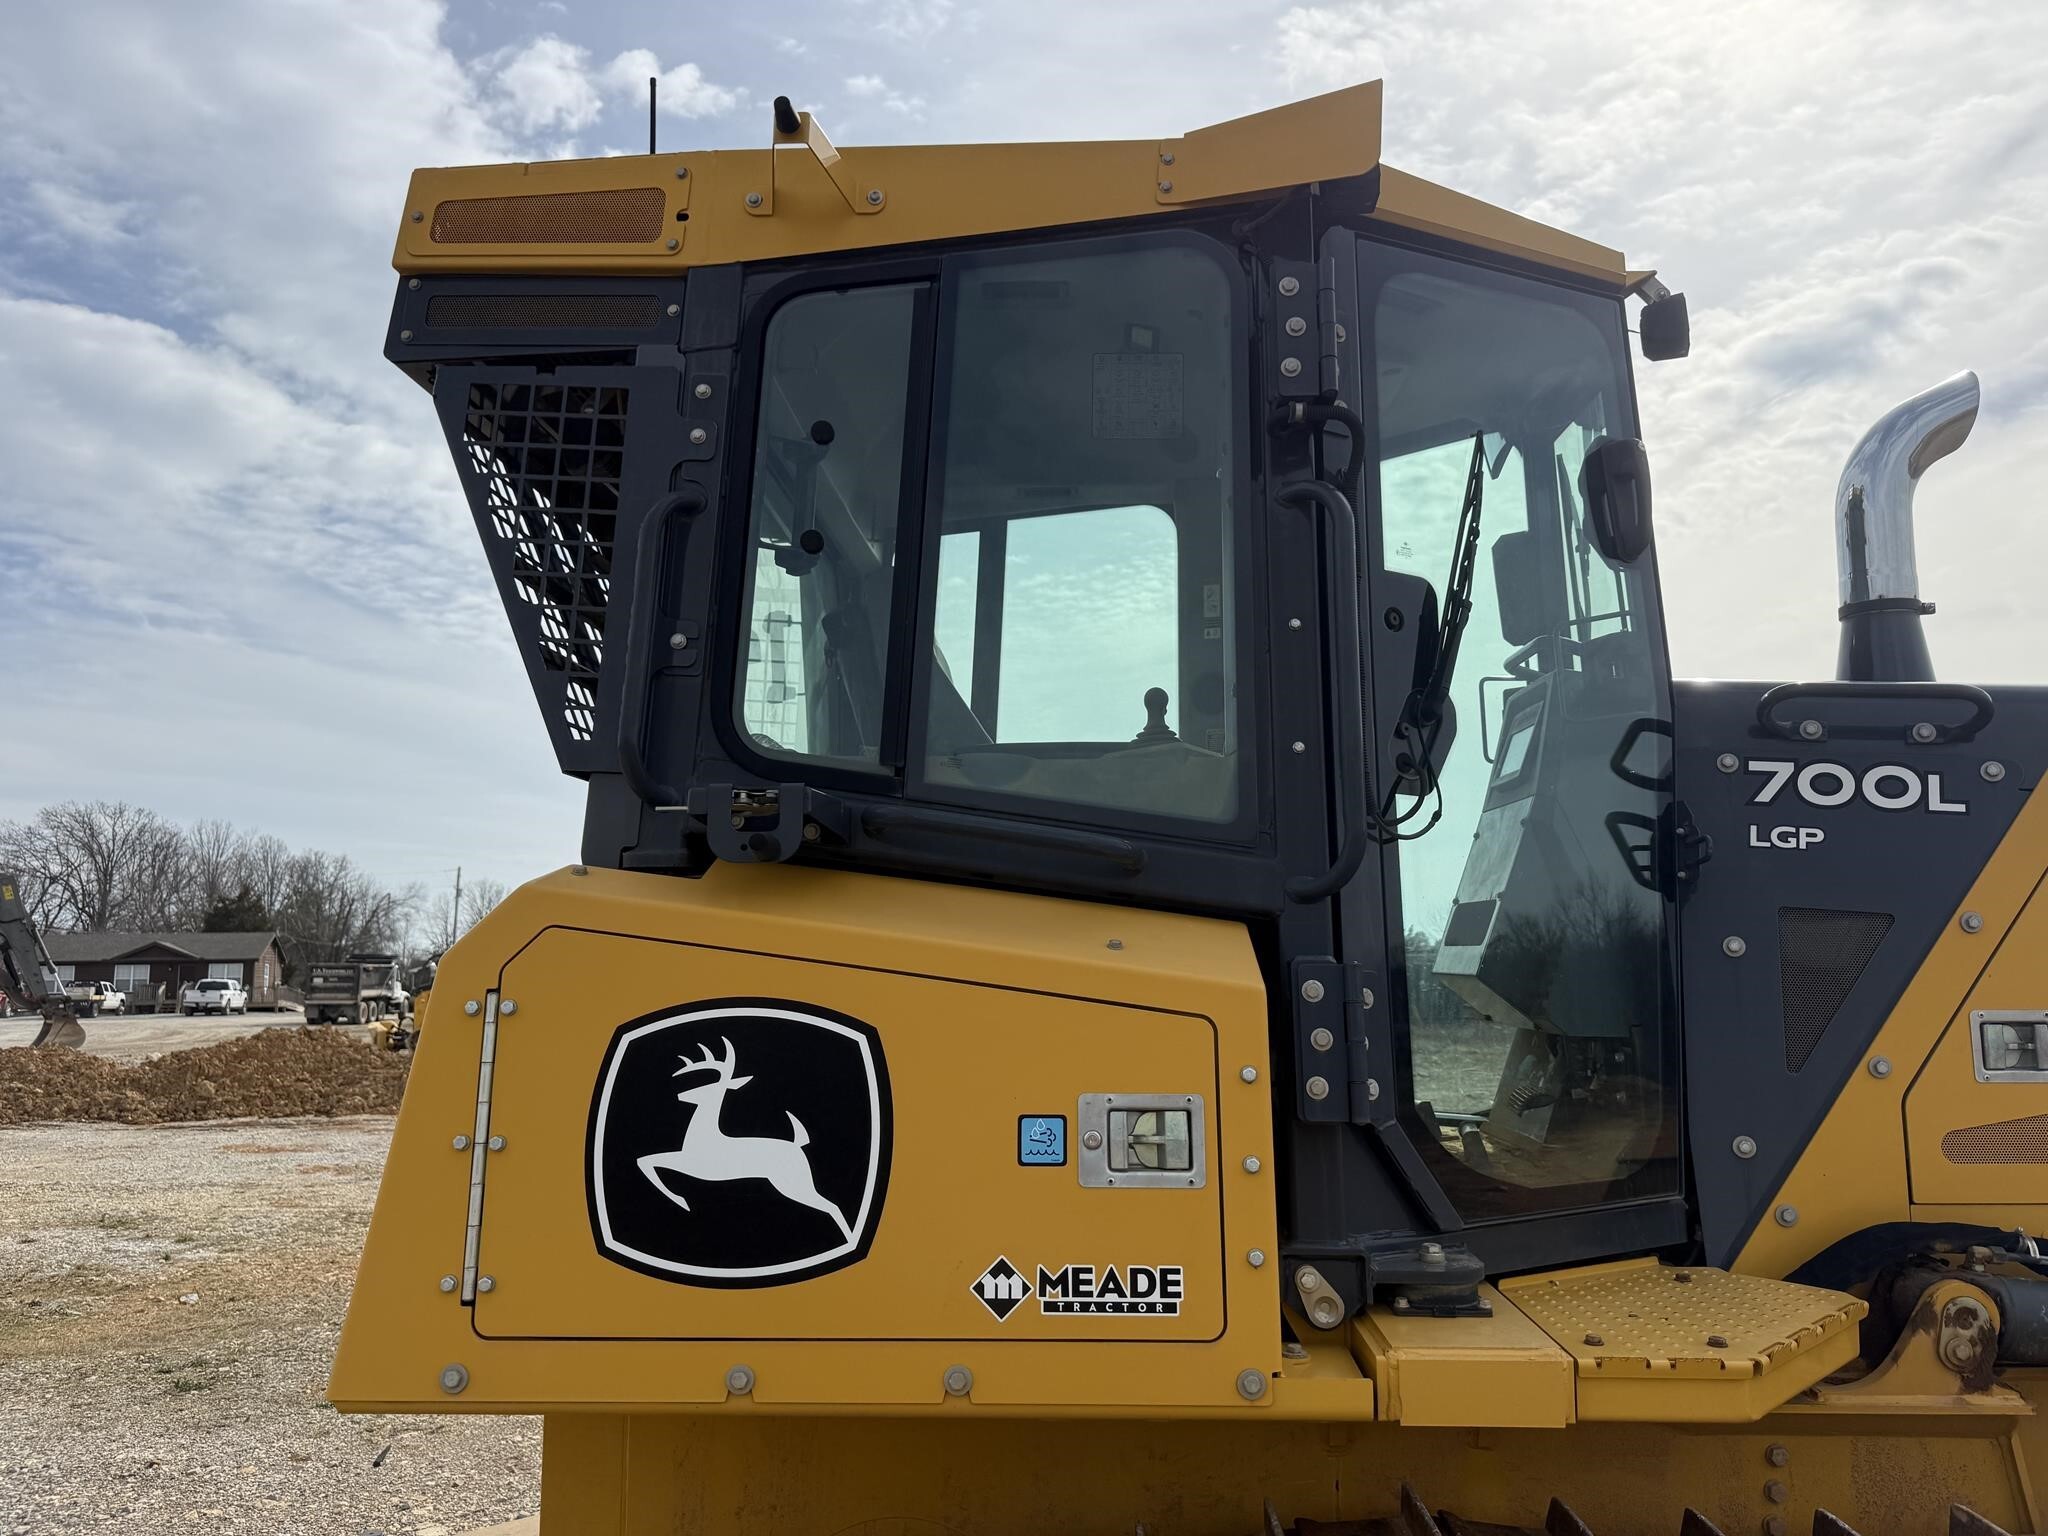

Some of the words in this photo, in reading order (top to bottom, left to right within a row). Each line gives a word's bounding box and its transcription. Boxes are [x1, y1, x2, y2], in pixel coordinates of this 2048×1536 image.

[1749, 760, 1966, 812] 700L
[1749, 824, 1825, 850] LGP
[1038, 1265, 1182, 1299] MEADE
[1057, 1302, 1163, 1312] TRACTOR
